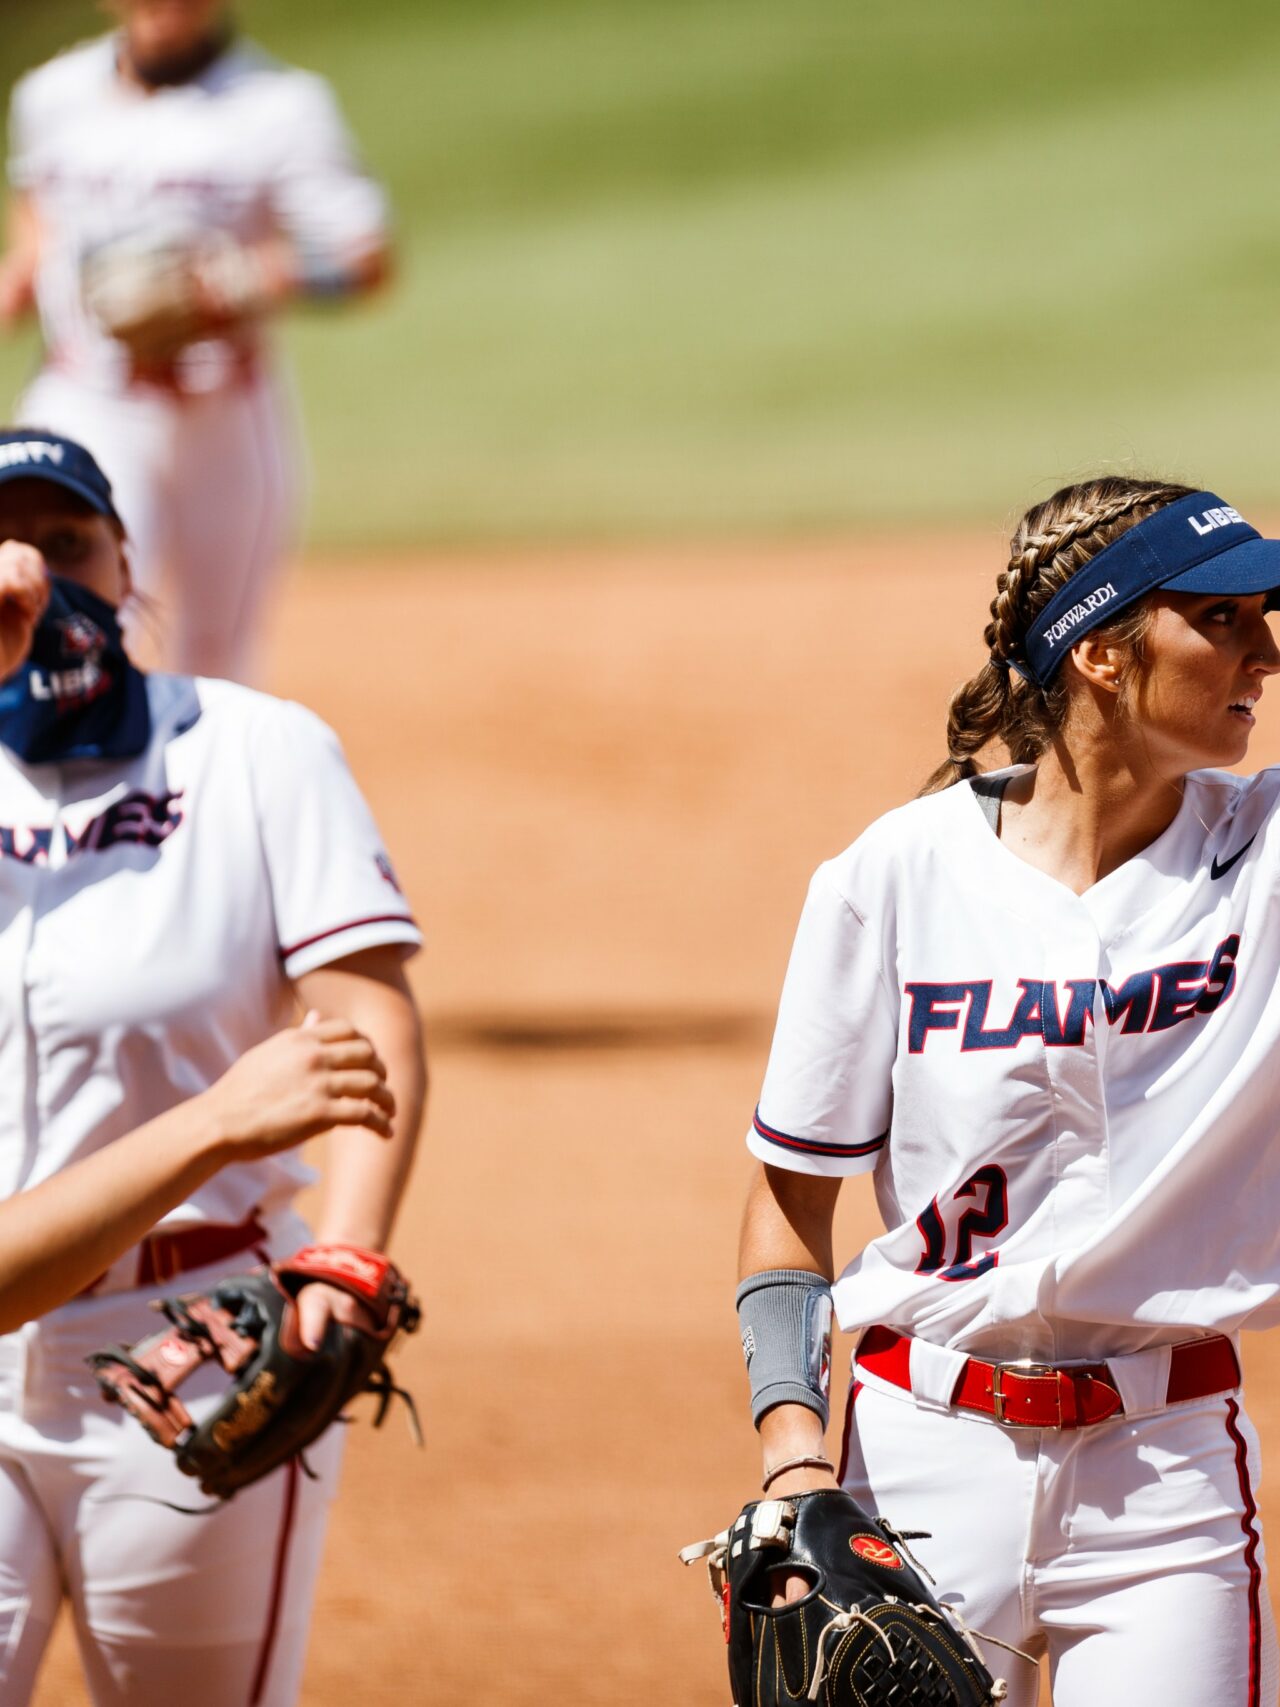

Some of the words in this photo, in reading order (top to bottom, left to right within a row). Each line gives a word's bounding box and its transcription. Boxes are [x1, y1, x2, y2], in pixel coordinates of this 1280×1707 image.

[1042, 582, 1119, 648] FORWARD1
[904, 934, 1240, 1054] FLAMES
[913, 1163, 1009, 1282] 12
